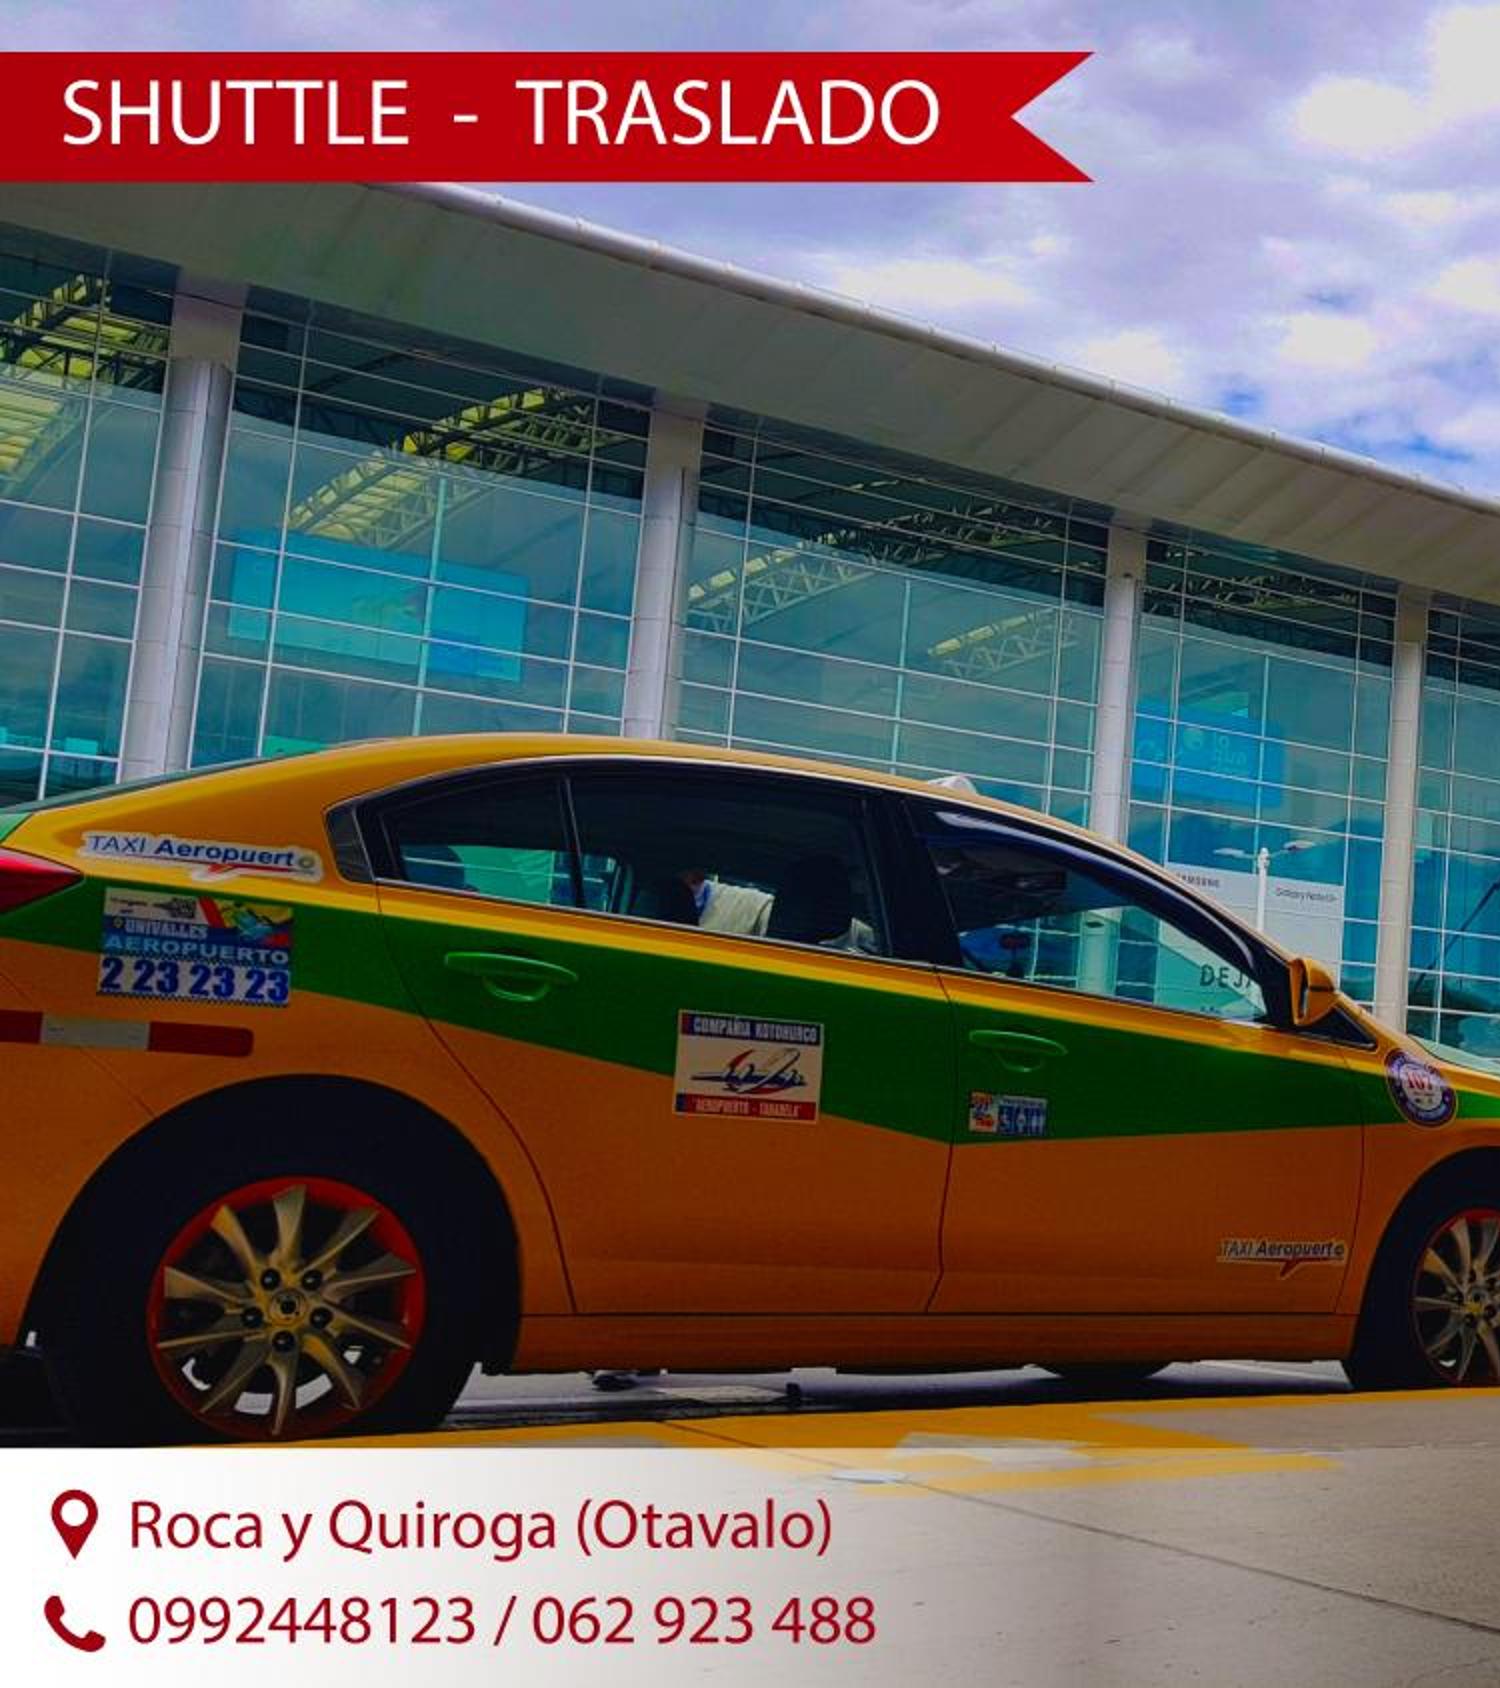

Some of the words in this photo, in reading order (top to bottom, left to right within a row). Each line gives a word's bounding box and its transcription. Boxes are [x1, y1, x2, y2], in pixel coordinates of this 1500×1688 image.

[90, 835, 147, 853] TAXI
[153, 839, 317, 869] Aeropuerto
[125, 918, 209, 940] UNIVALLES
[103, 935, 290, 965] AEROPUERTO
[101, 957, 124, 991] 2
[133, 958, 180, 994] 23
[189, 964, 237, 1000] 23
[244, 969, 290, 1001] 23
[1222, 1238, 1253, 1257] TAXI
[1256, 1240, 1344, 1258] Aeropuerto
